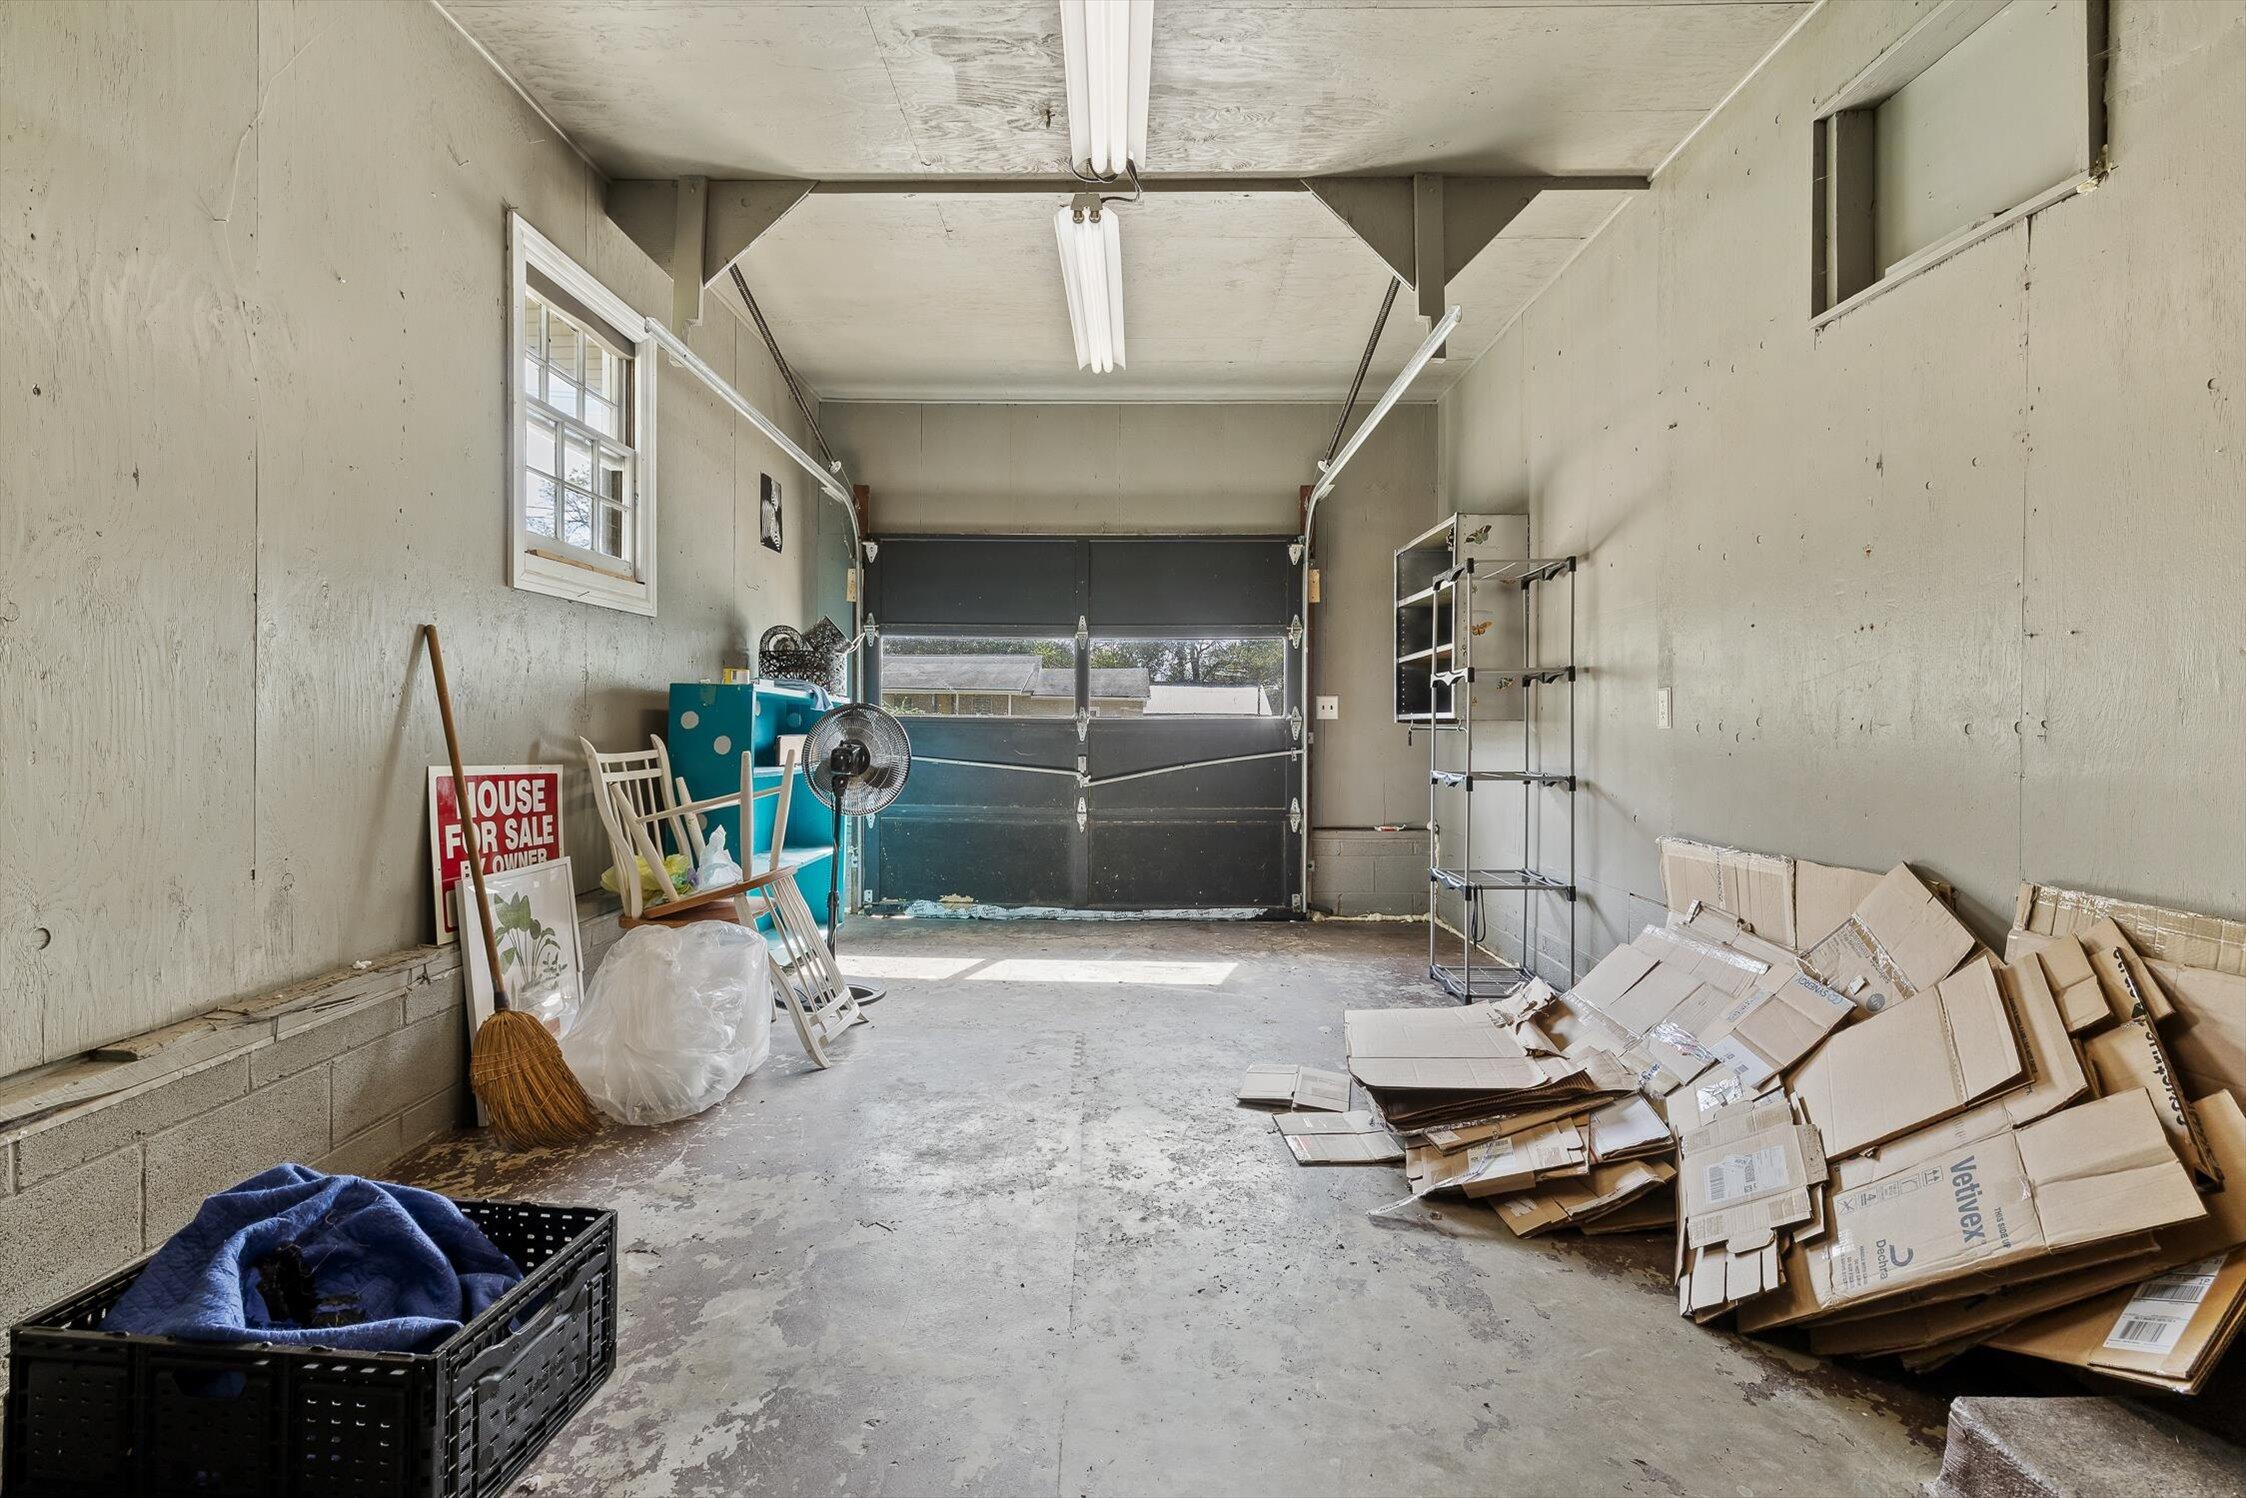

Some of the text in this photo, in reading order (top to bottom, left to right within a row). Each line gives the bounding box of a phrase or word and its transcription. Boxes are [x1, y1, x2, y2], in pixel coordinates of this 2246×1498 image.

[504, 815, 554, 850] SALE
[492, 848, 548, 873] OWNER
[1796, 976, 1829, 997] SYNERGY
[1950, 1155, 1985, 1243] Vetivex
[1994, 1207, 2003, 1222] THIS
[1998, 1222, 2008, 1238] SIDE
[1875, 1239, 1888, 1280] Dechra
